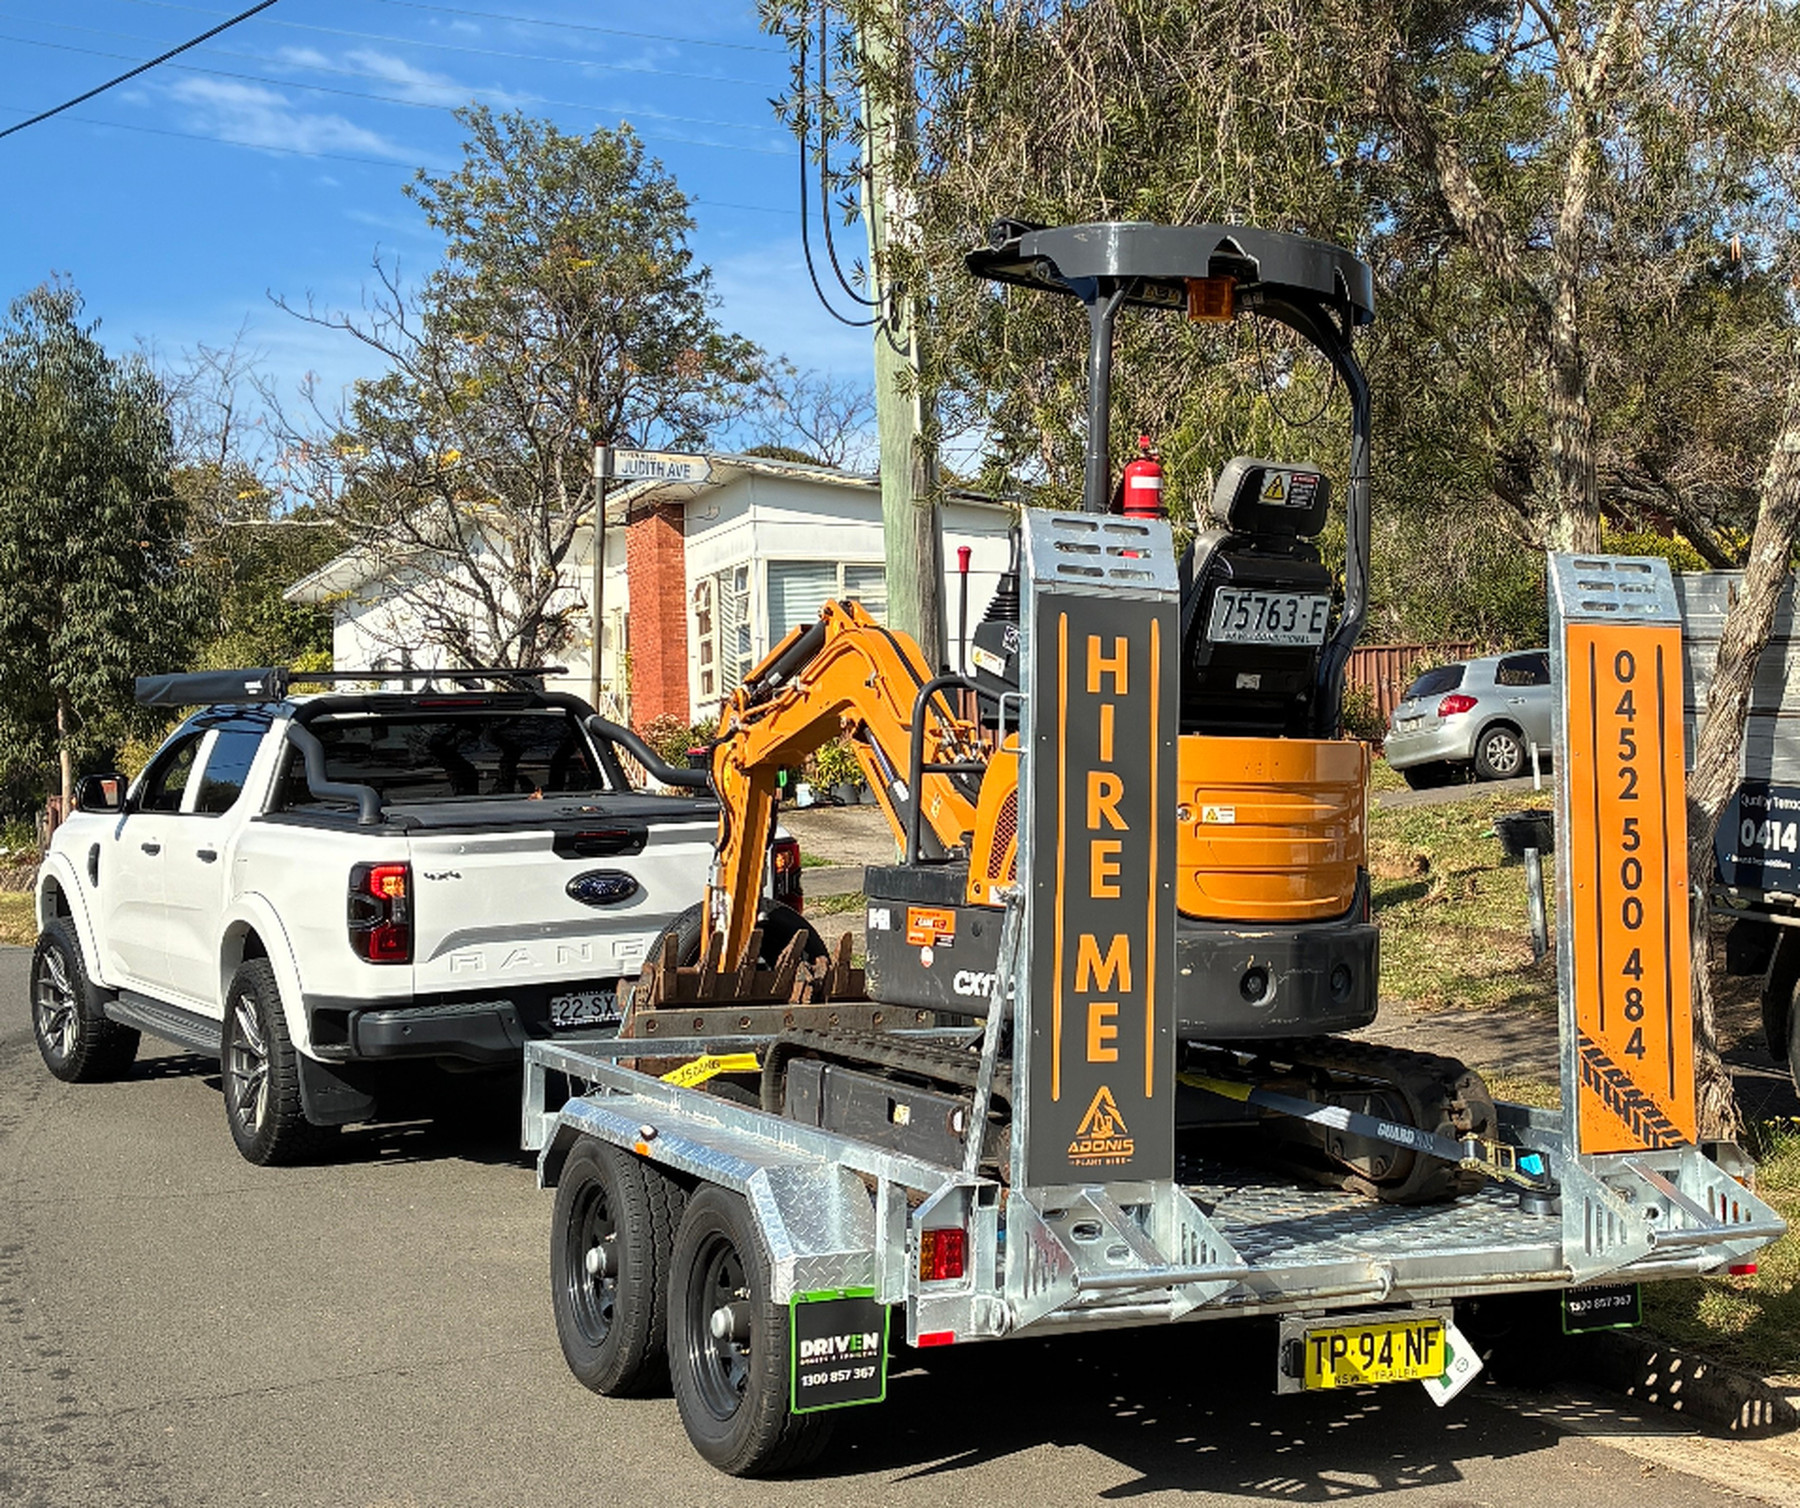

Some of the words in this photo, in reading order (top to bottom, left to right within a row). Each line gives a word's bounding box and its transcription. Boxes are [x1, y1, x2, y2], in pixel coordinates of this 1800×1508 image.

[621, 460, 665, 477] JUDITH
[666, 462, 691, 479] AVE
[1614, 649, 1639, 801] 0452
[1086, 634, 1130, 899] HIRE
[1740, 818, 1798, 853] 0414
[1620, 816, 1645, 931] 500
[1073, 933, 1132, 1063] ME
[1622, 947, 1647, 1061] 484
[1067, 1138, 1135, 1157] ADONIS
[1074, 1157, 1102, 1167] PLANT
[800, 1332, 880, 1358] DRIVEN
[801, 1371, 829, 1387] 1300
[829, 1369, 852, 1383] 857
[852, 1366, 876, 1379] 367
